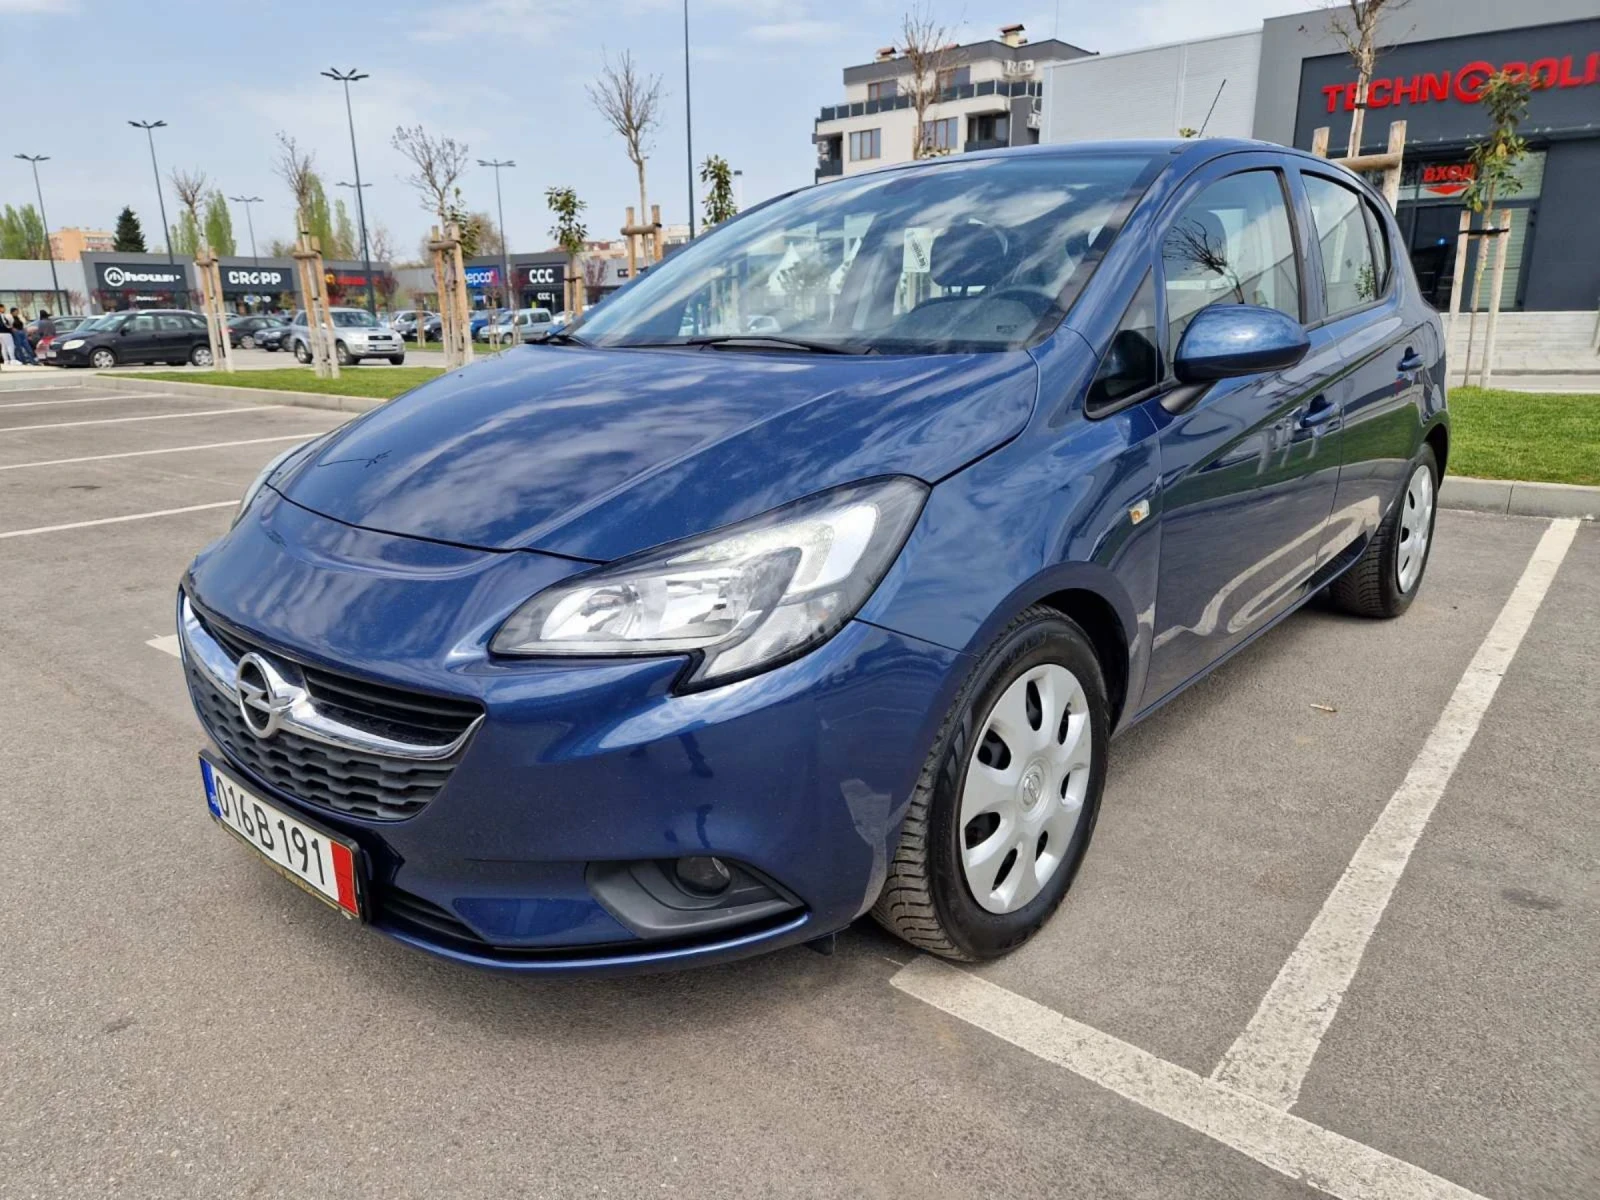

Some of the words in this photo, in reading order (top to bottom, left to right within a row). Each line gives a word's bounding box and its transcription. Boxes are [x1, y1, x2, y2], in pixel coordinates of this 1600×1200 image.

[1322, 51, 1600, 113] TECHNOPOLI
[464, 269, 494, 285] epco
[529, 269, 554, 283] CCC
